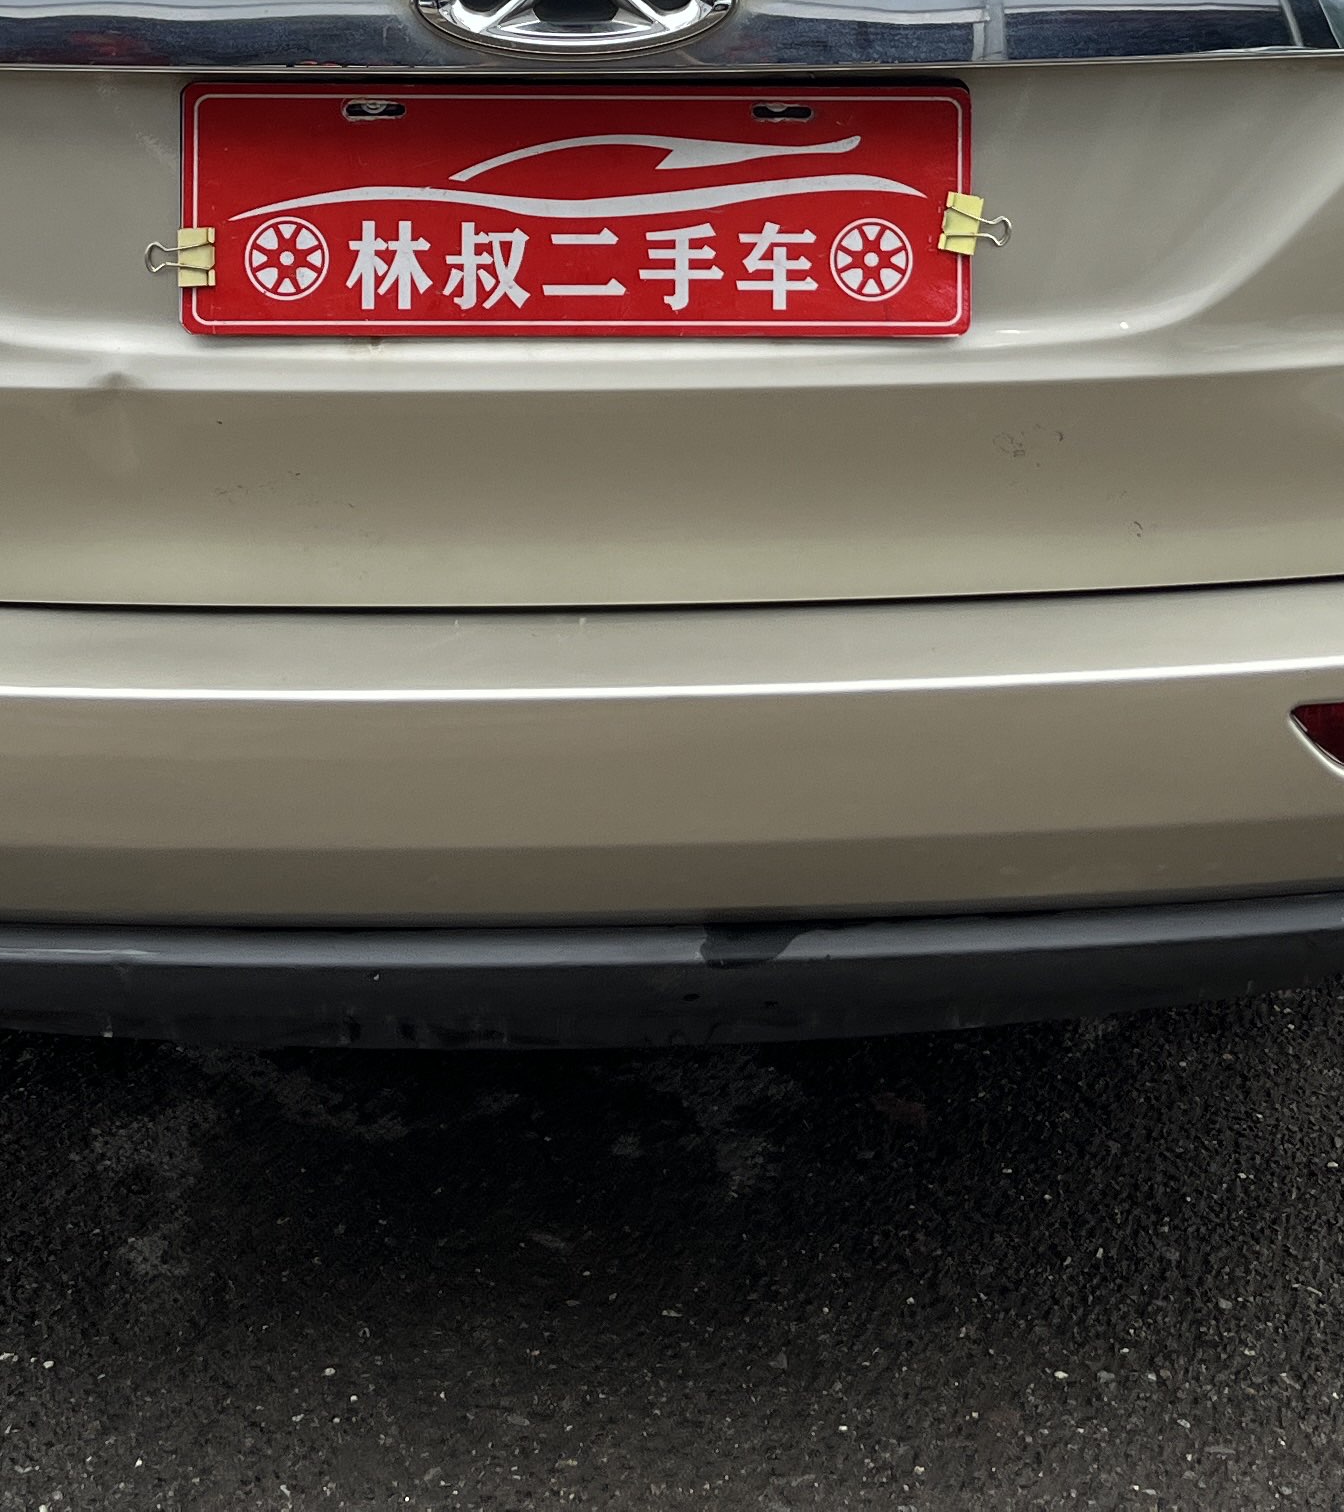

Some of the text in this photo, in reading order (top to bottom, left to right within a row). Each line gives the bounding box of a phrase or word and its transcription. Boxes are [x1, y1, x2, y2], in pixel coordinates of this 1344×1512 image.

[346, 220, 819, 312] 林叔二手车
